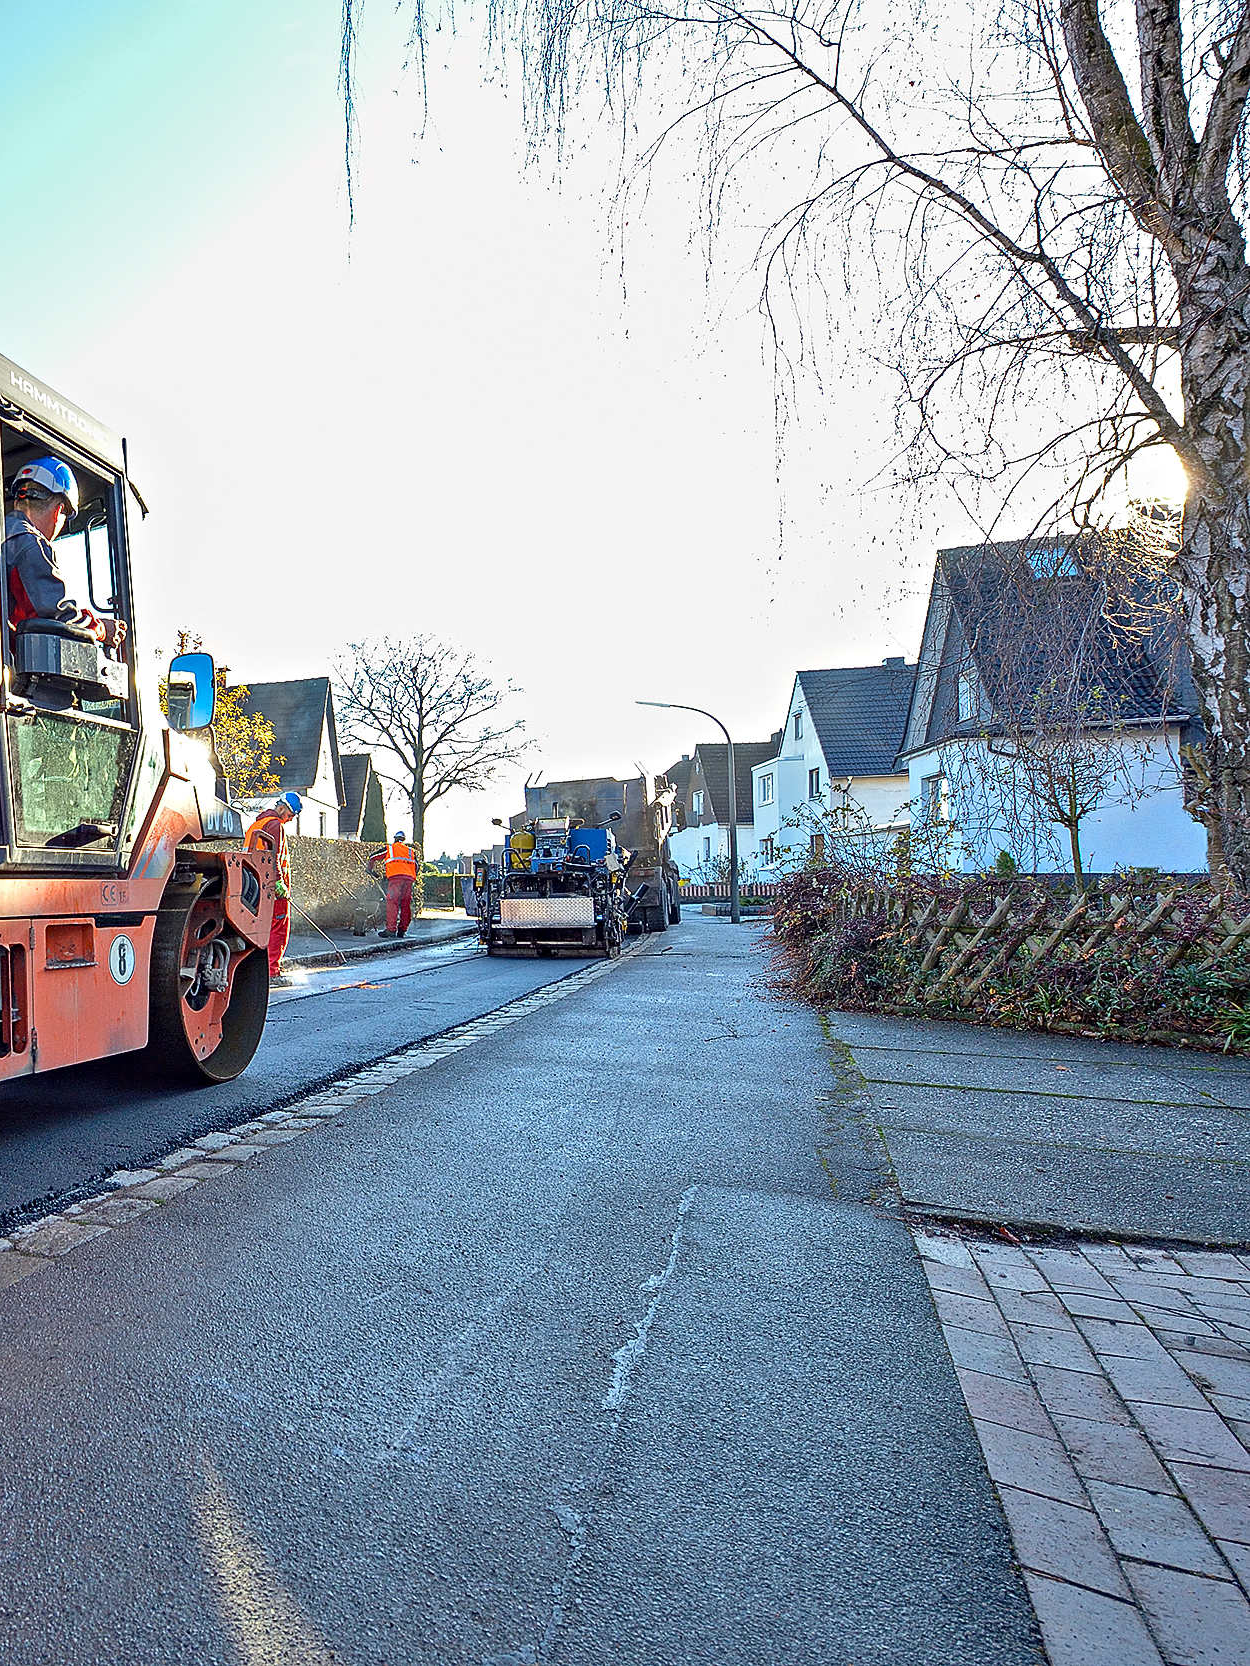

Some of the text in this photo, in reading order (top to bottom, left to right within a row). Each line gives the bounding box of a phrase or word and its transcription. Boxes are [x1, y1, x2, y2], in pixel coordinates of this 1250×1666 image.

[10, 370, 109, 444] HAMMTRON
[207, 810, 234, 833] DV 40
